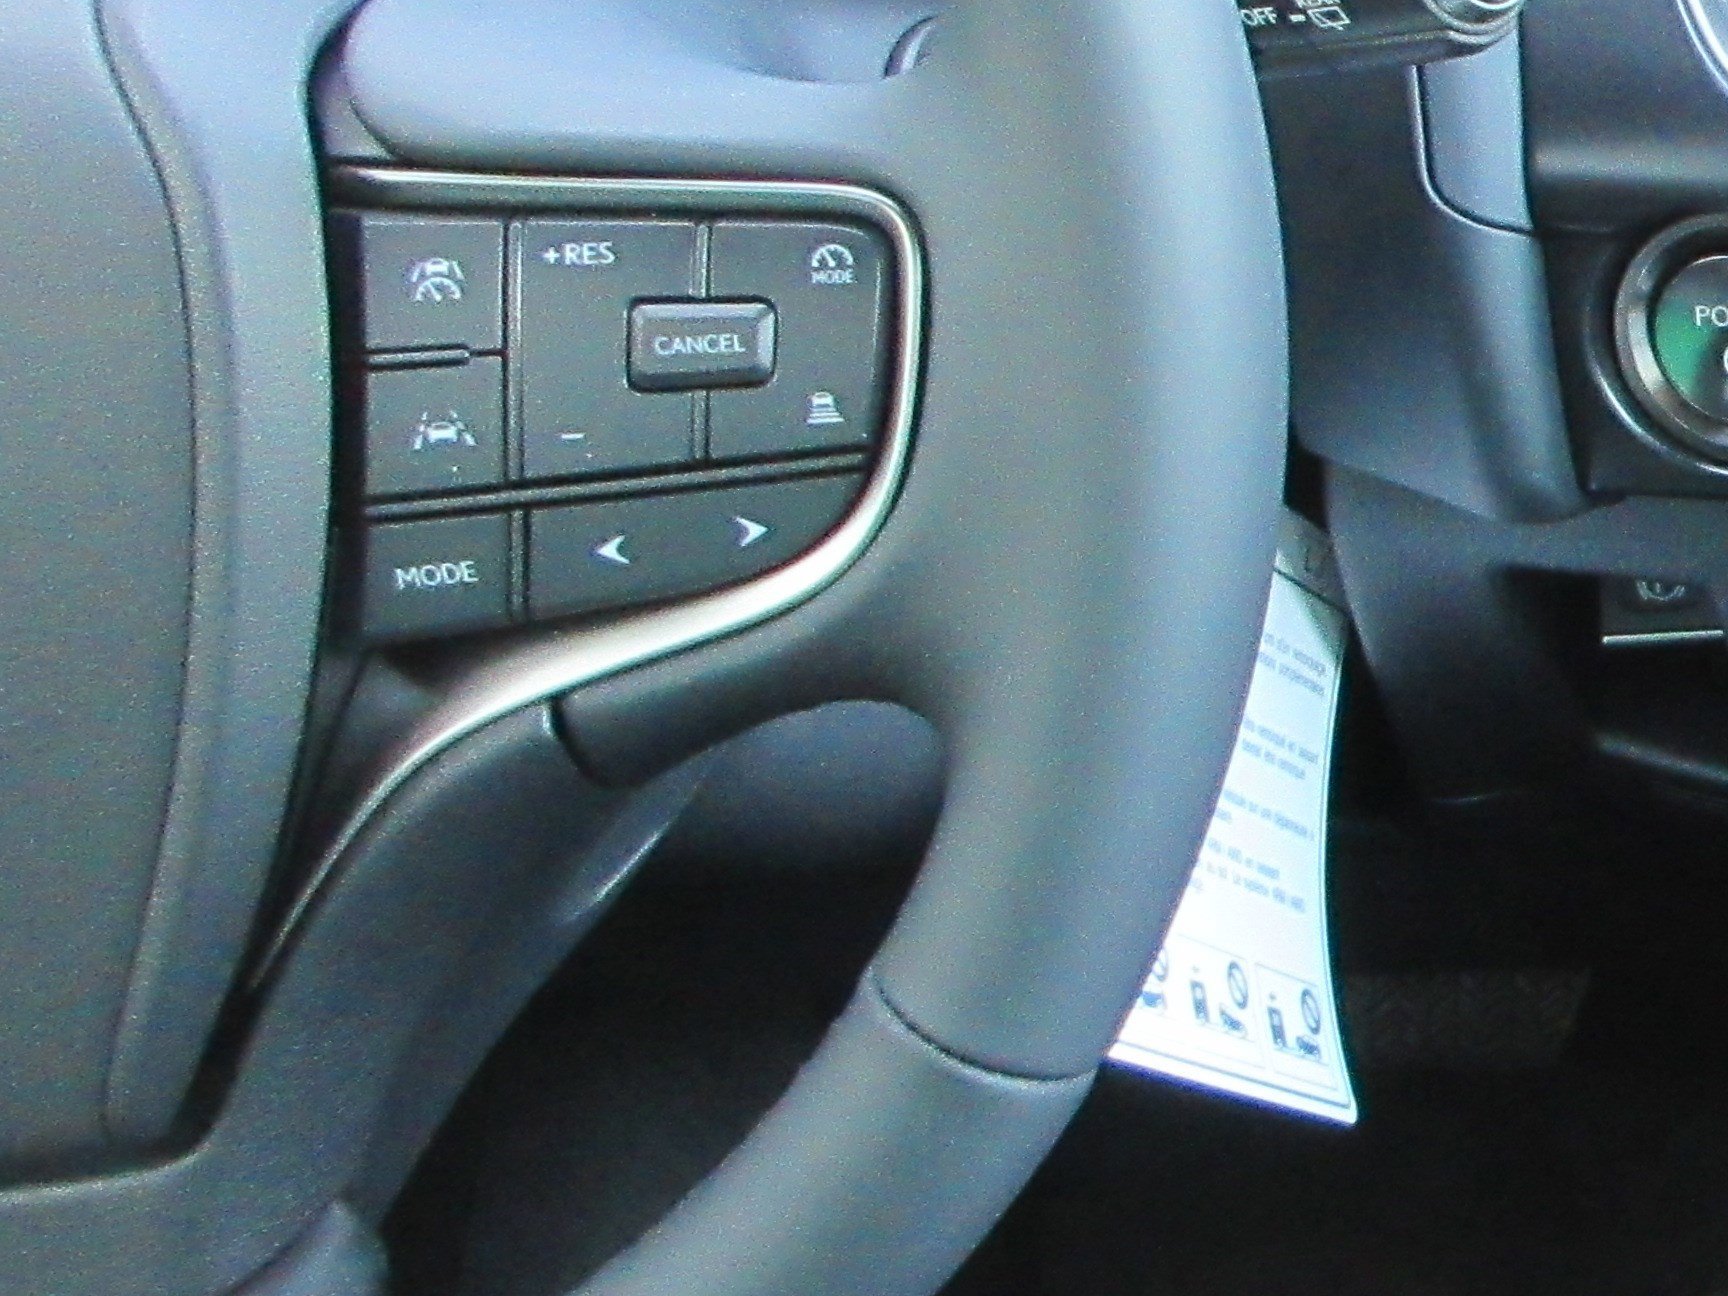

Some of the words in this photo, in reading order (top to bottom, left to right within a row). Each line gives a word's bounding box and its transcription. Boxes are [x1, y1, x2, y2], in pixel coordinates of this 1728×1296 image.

[1240, 6, 1278, 26] OFF
[810, 270, 855, 284] MODE
[653, 333, 747, 357] CANCEL
[394, 561, 479, 591] MODE
